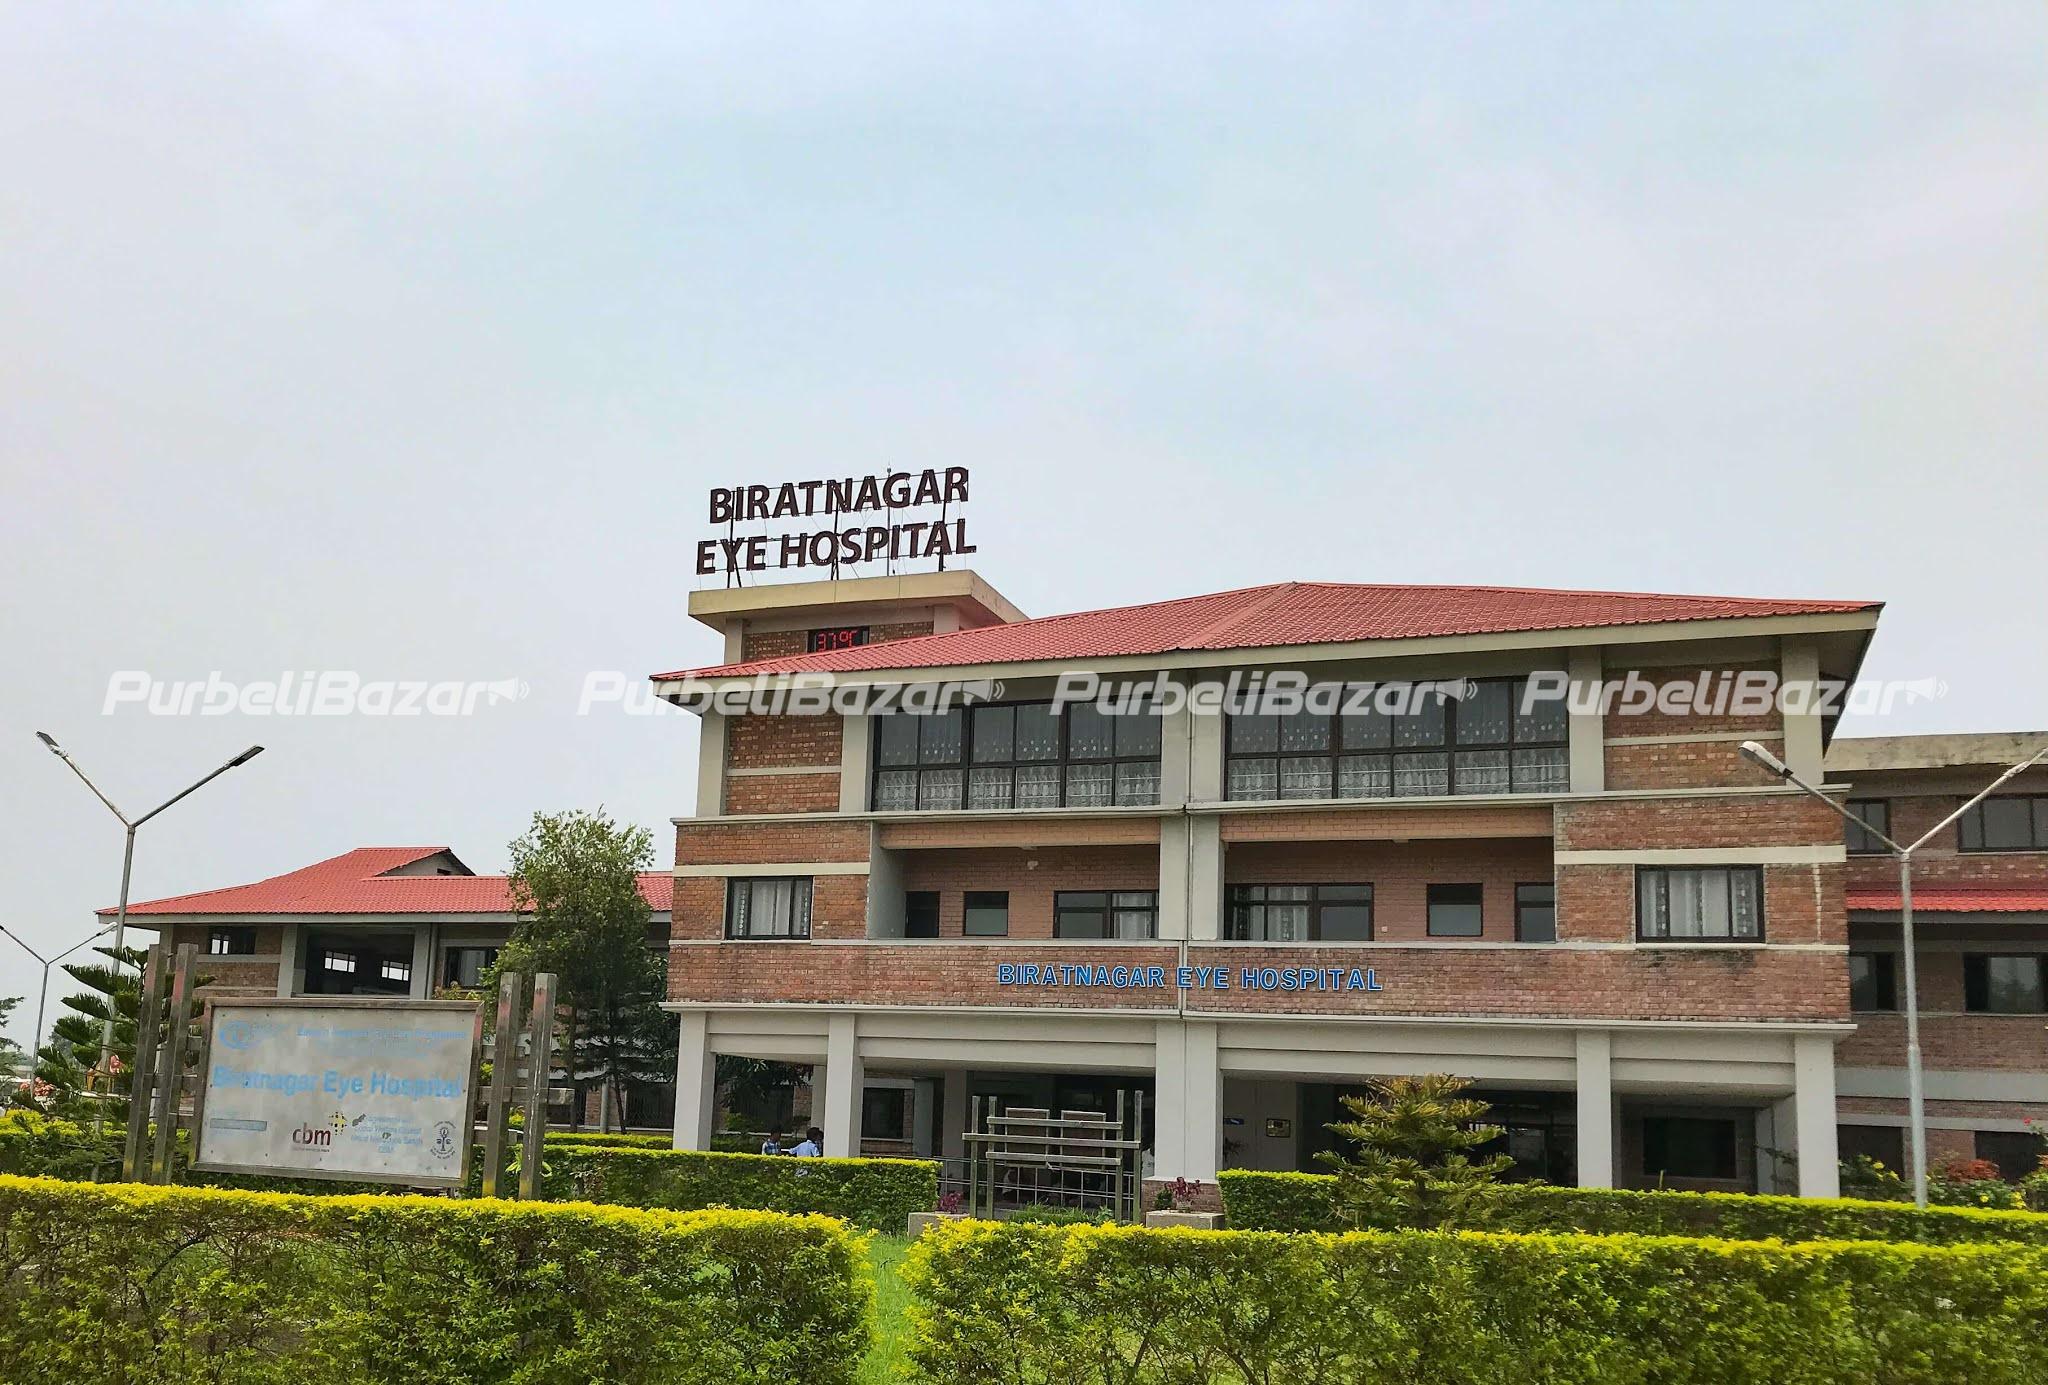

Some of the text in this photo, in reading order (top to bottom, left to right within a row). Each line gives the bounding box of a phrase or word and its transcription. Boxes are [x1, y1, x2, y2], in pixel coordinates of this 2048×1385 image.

[710, 466, 969, 523] BIRATNAGAR
[696, 517, 977, 575] EYE HOSPITAL
[997, 963, 1384, 992] BIRATNAGAR EYE HOSPITAL
[323, 1070, 363, 1099] Eye
[369, 1071, 462, 1102] Hospital
[292, 1122, 331, 1147] cbm
